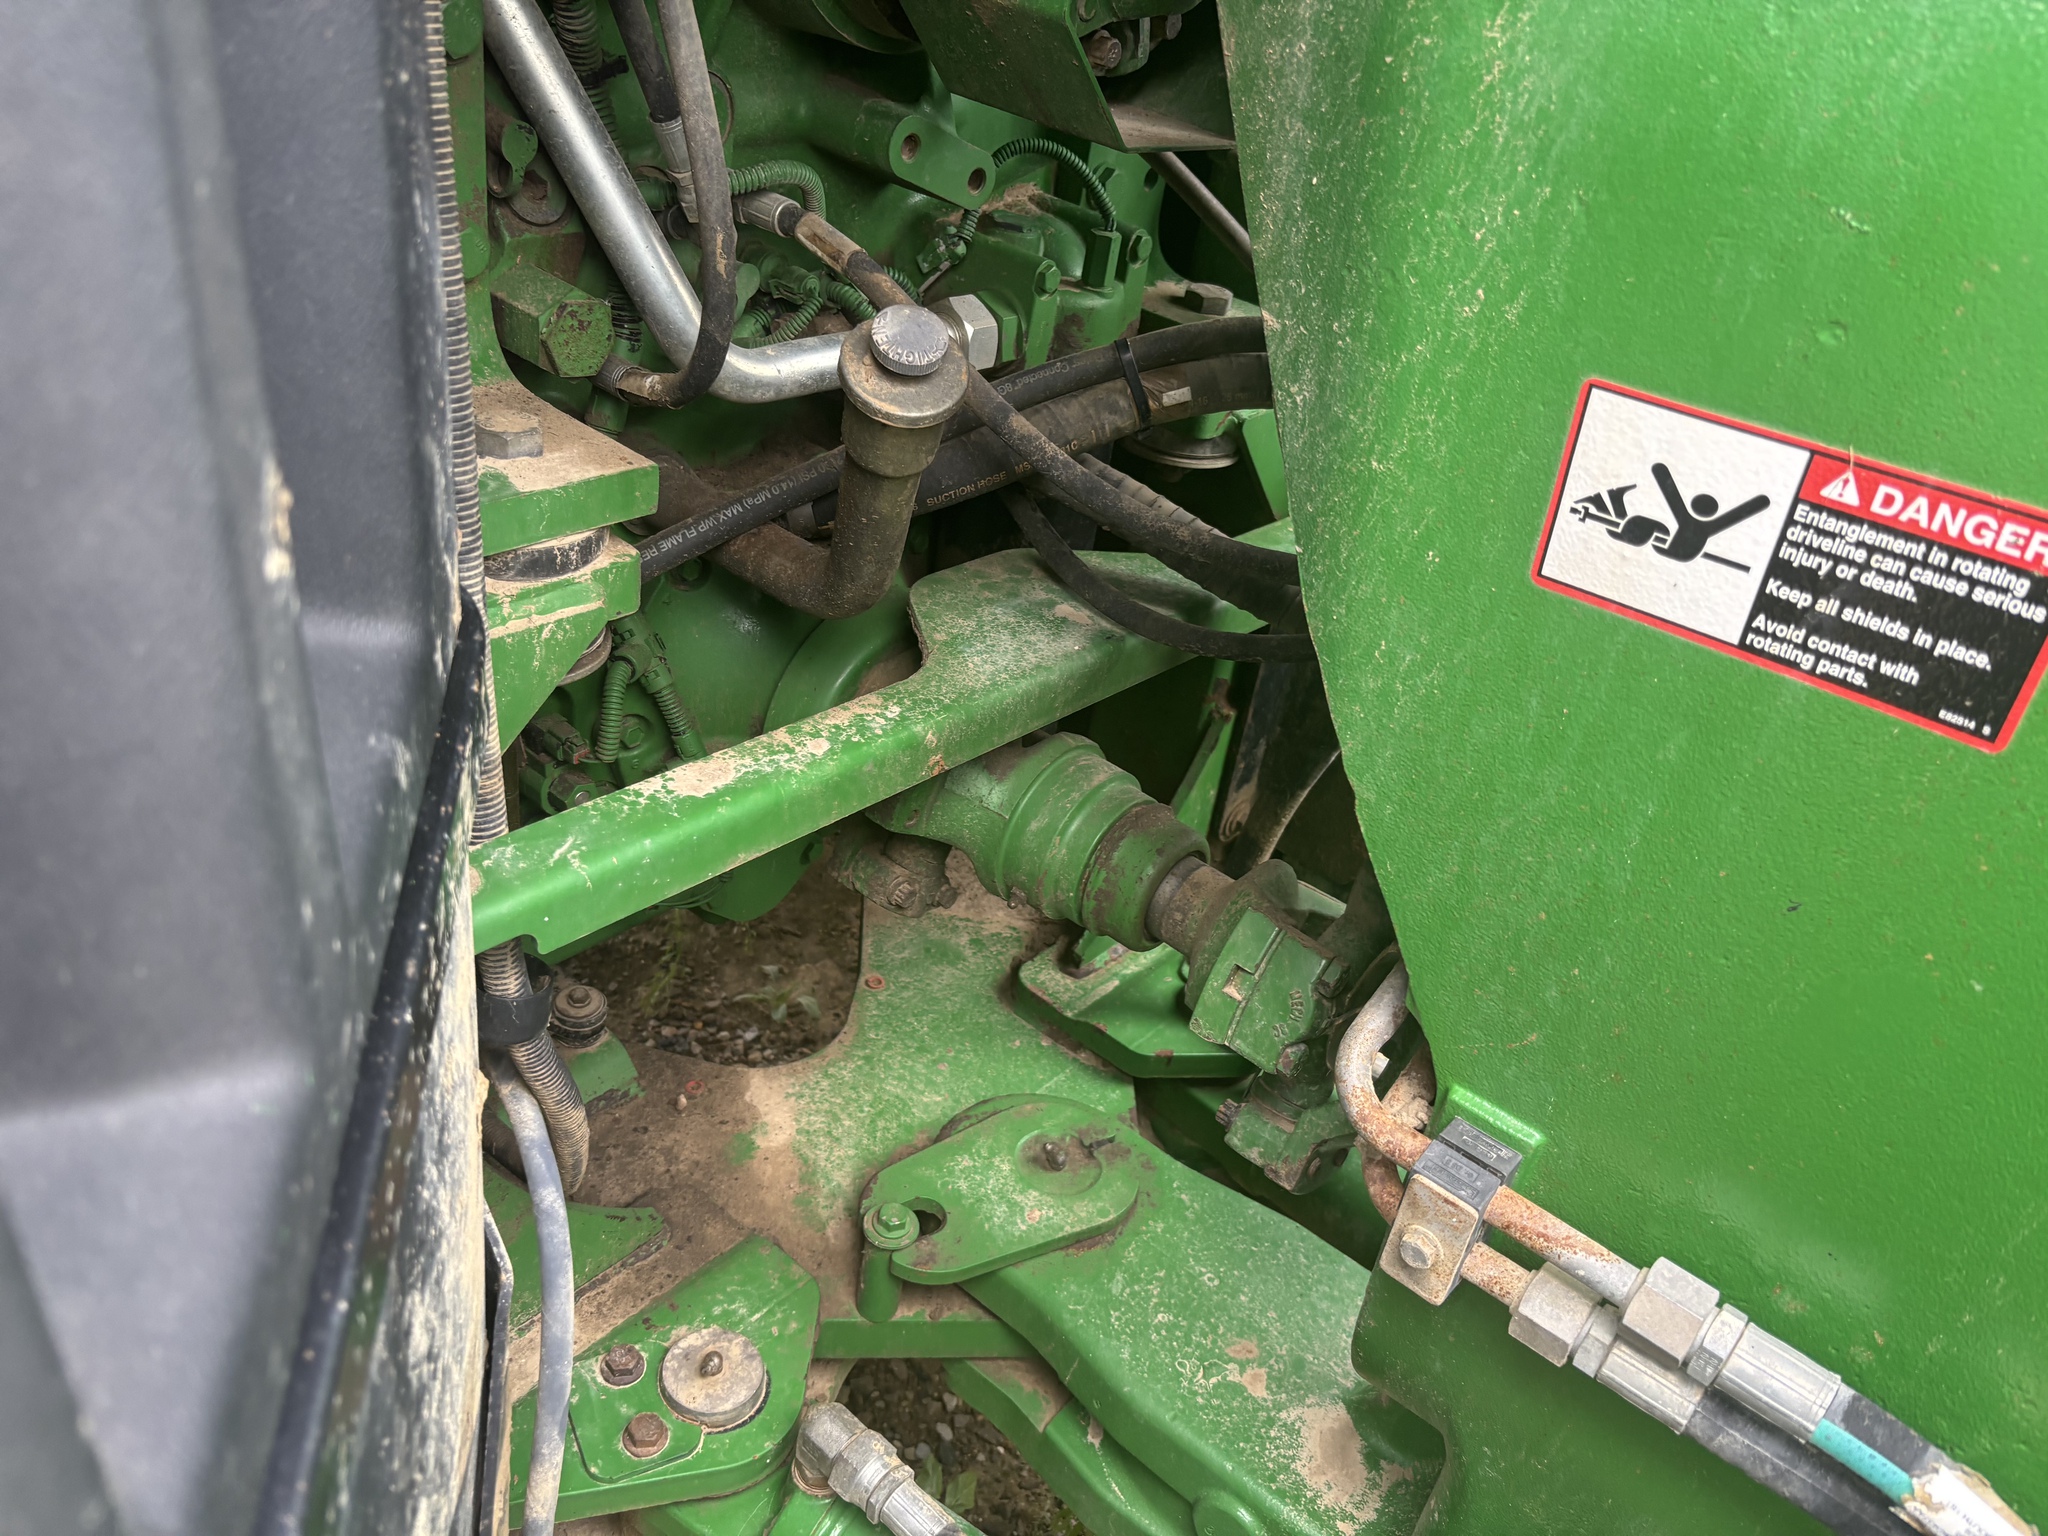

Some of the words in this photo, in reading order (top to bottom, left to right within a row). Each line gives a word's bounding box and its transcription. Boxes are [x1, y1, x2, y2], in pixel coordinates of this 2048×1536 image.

[743, 489, 771, 510] MPa)
[926, 484, 975, 507] SUCTION
[977, 471, 1008, 490] HOSE
[658, 526, 697, 551] FLAME
[1793, 503, 1926, 560] Entanglement
[1928, 545, 1949, 568] in
[1951, 555, 2031, 598] rotating
[1778, 541, 1833, 577] injury
[1835, 563, 1858, 581] or
[1859, 570, 1917, 603] death.
[1786, 524, 1867, 564] driveline
[1870, 552, 1907, 576] can
[1909, 565, 1969, 597] cause
[1971, 584, 2047, 623] serious
[1751, 613, 1806, 644] Avoid
[1807, 635, 1877, 671] contact
[1879, 658, 1920, 686] with
[1765, 577, 1813, 609] Keep
[1815, 598, 1841, 617] all
[1841, 606, 1911, 641] shields
[1912, 626, 1933, 649] in
[1933, 638, 1992, 673] place.
[1745, 632, 1815, 671] rotating
[1815, 658, 1868, 688] parts.
[1938, 707, 1976, 730] E82514
